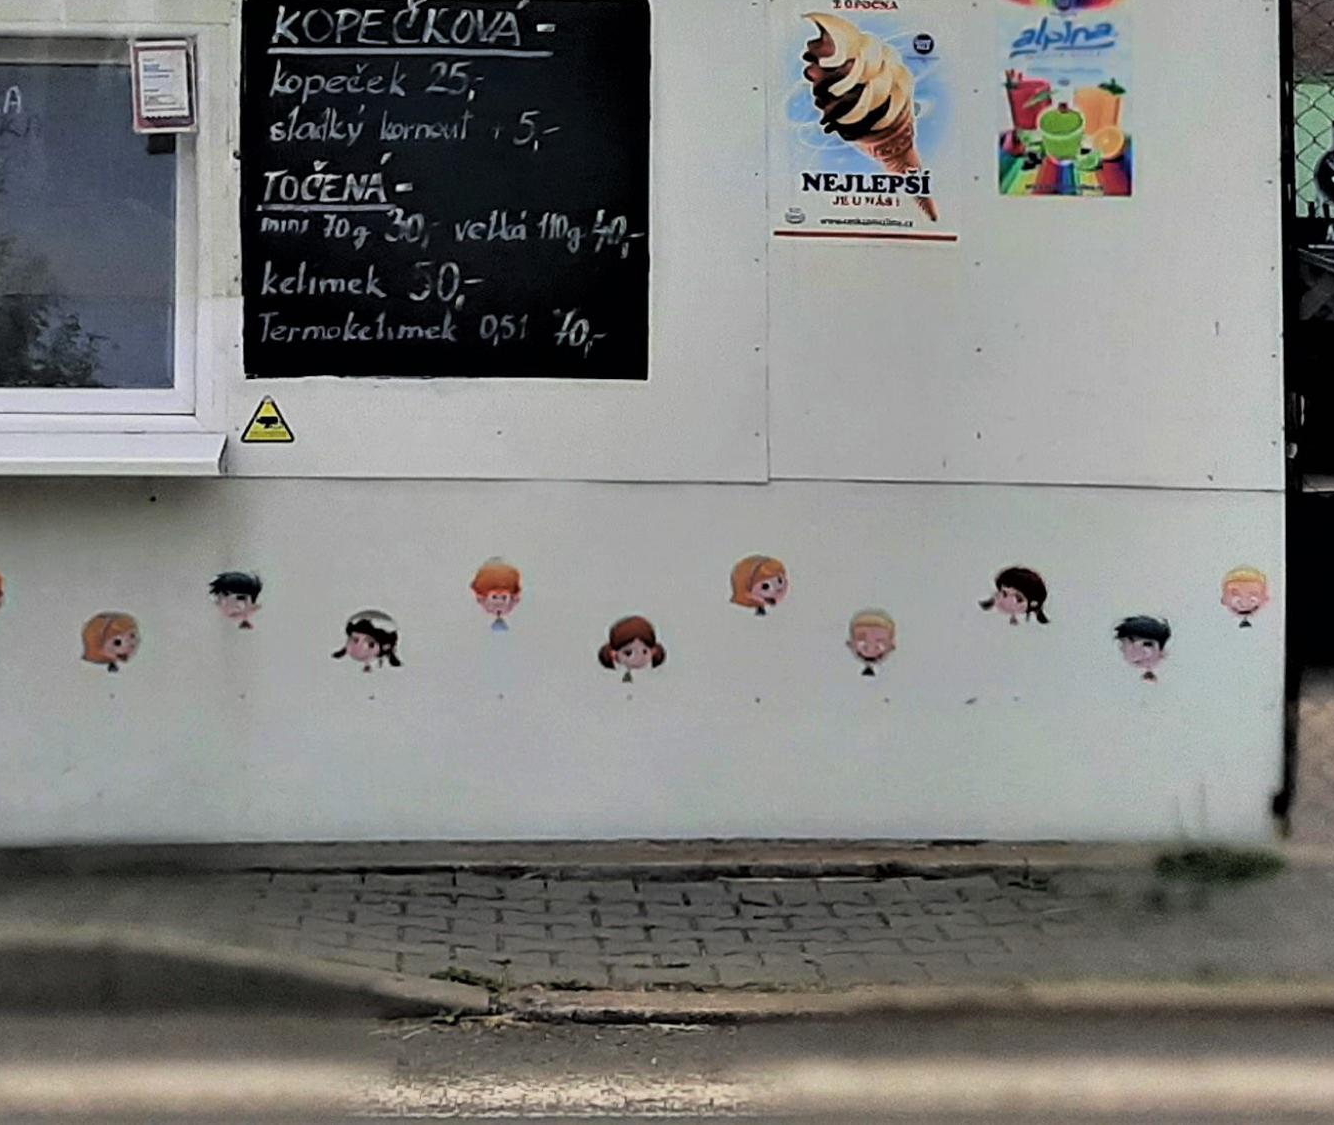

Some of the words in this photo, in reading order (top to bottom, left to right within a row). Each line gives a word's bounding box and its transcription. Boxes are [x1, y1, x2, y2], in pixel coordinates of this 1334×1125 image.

[269, 59, 407, 103] kopeček
[269, 104, 365, 146] sladký
[380, 110, 474, 141] kornout
[264, 152, 392, 202] TOČENÁ
[801, 170, 930, 194] NEJLEPŠÍ
